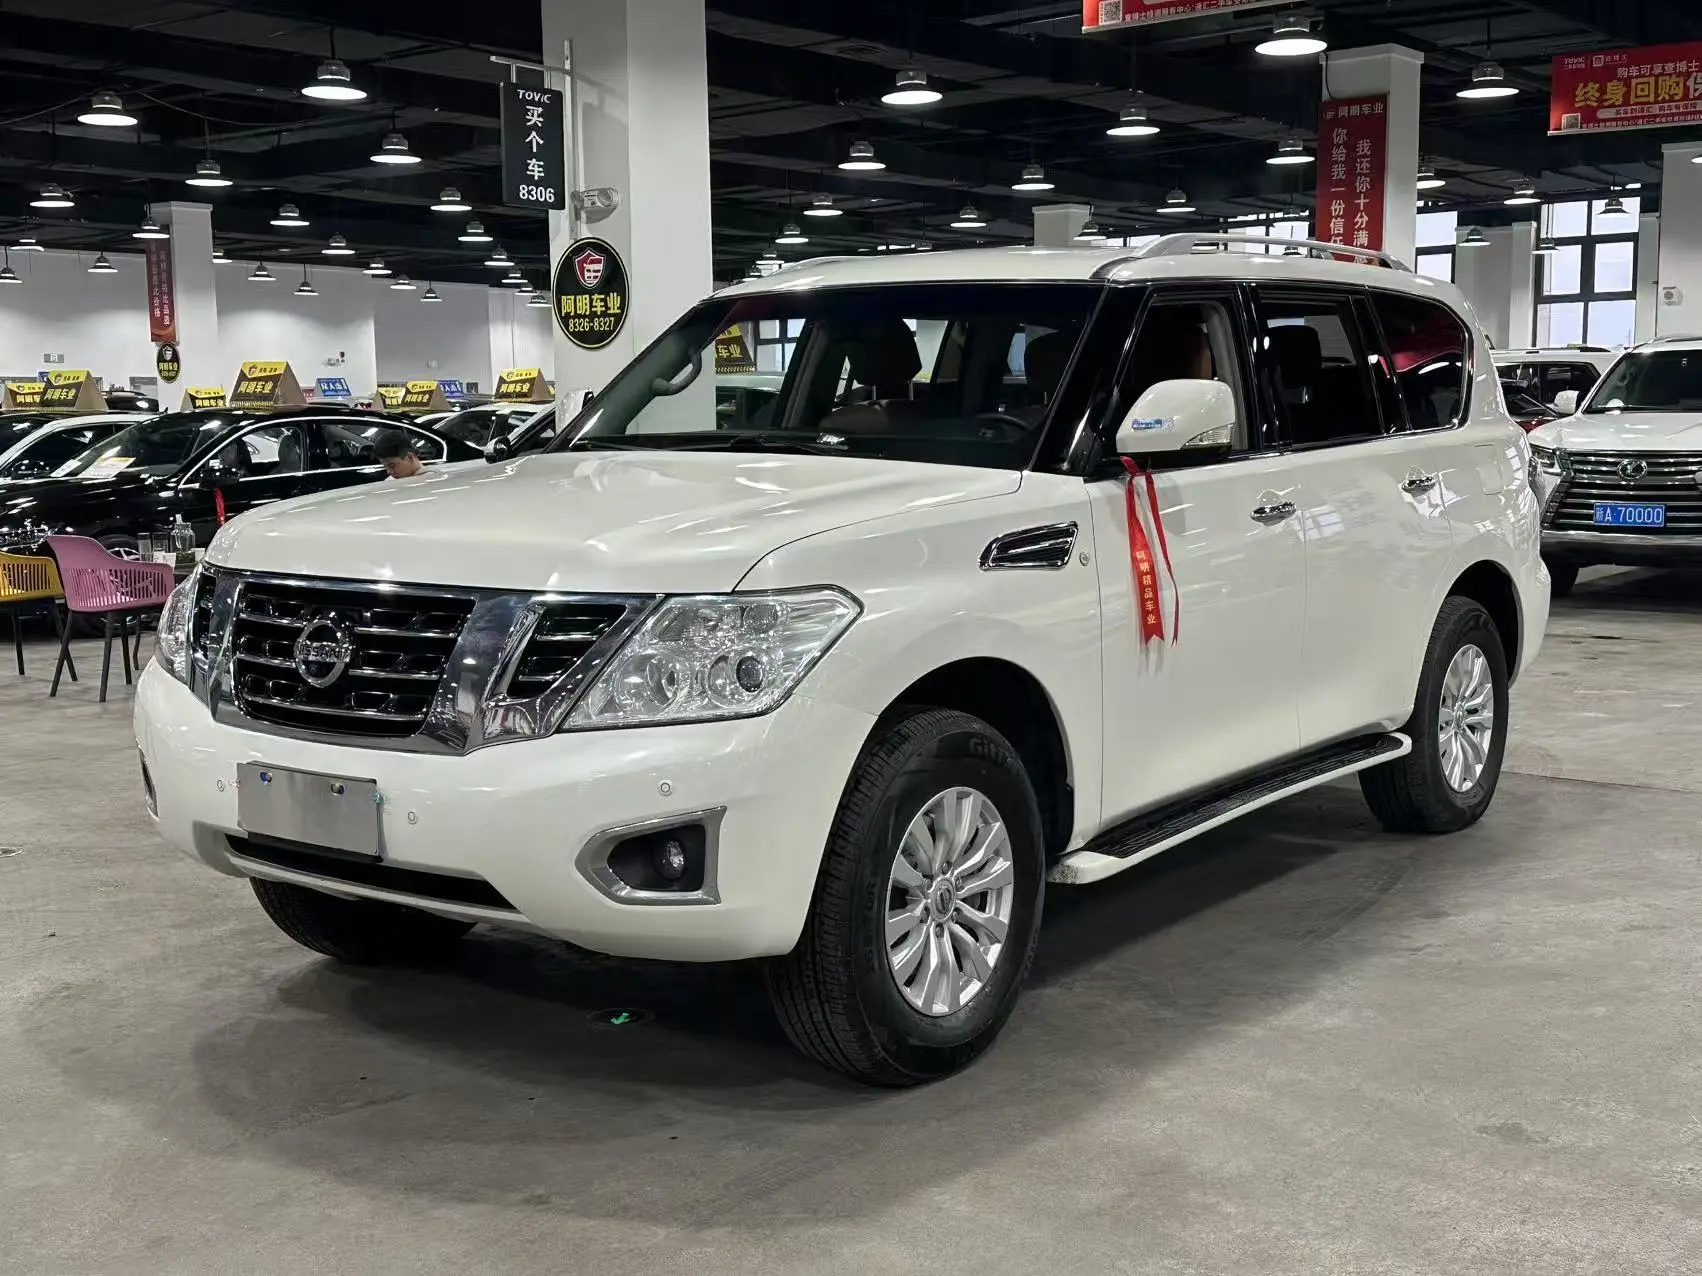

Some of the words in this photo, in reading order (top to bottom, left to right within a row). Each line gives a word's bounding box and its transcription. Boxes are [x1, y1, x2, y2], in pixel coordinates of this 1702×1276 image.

[1617, 60, 1700, 78] 购车可享查博士
[517, 89, 551, 104] TOVIC
[525, 105, 545, 181] 买个车
[519, 184, 555, 203] 8306
[561, 292, 622, 317] 阿明车业
[568, 317, 615, 332] 8326-8327
[715, 344, 743, 358] 车业
[237, 381, 274, 393] 阿明车业
[1135, 550, 1156, 625] 阿明精品车业
